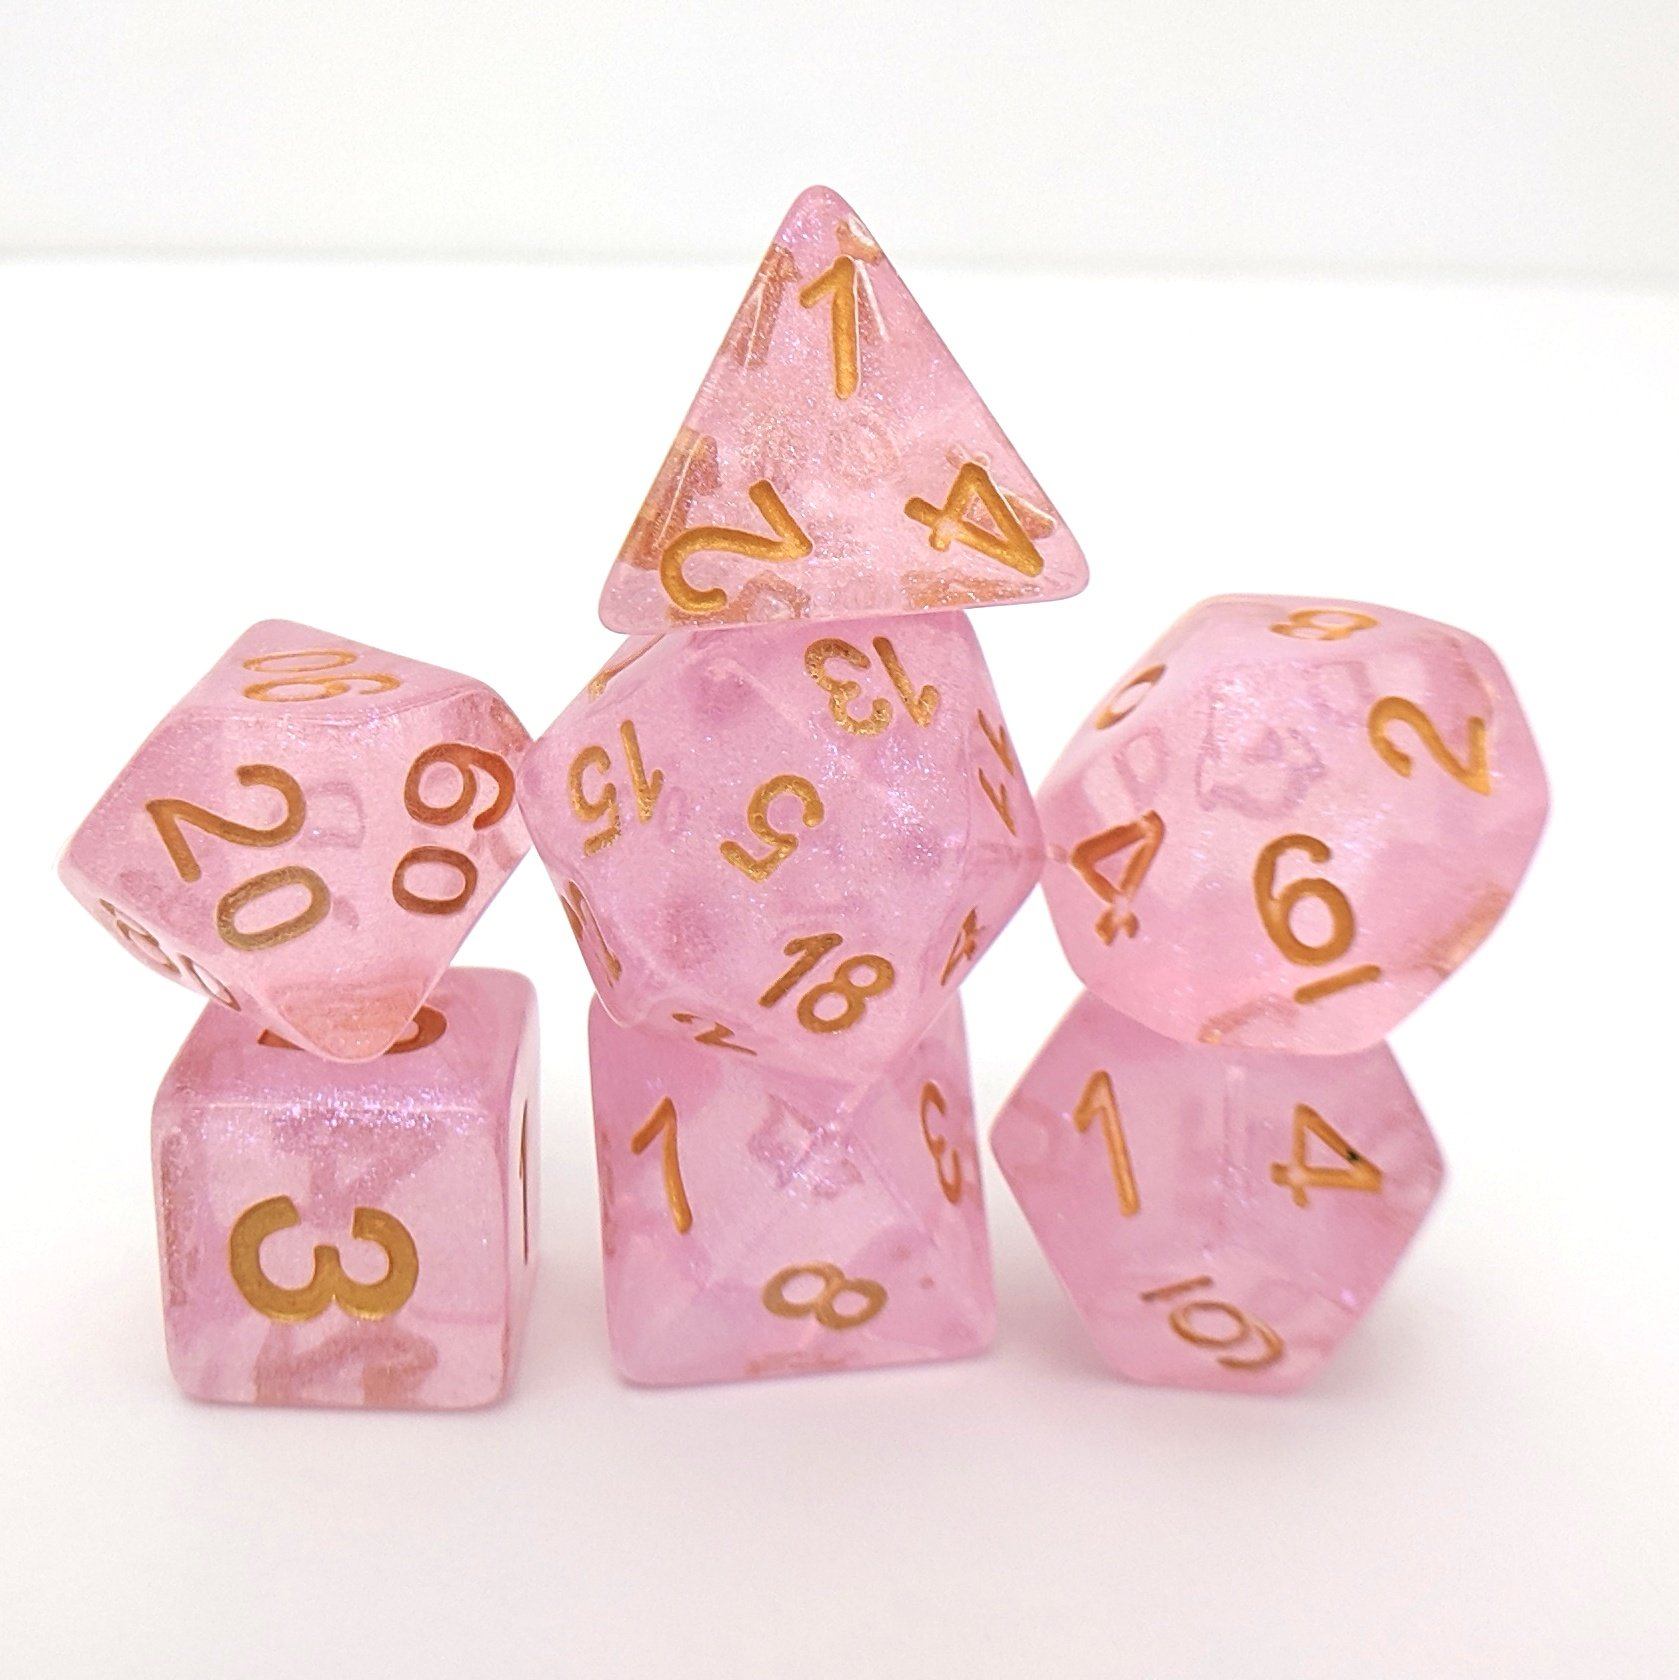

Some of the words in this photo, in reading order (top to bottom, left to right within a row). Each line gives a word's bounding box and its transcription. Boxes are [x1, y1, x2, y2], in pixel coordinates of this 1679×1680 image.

[800, 254, 861, 400] 1
[660, 479, 813, 613] 2
[904, 462, 1044, 577] 4
[804, 636, 941, 737] 13
[1270, 609, 1378, 640] 8
[567, 720, 664, 857] 15
[1367, 695, 1492, 796] 2
[146, 763, 331, 951] 20
[392, 743, 515, 915] 60
[720, 774, 825, 884] 5
[1070, 810, 1166, 946] 4
[758, 932, 895, 1033] 18
[921, 1081, 963, 1205] 3
[1073, 1070, 1140, 1217] 1
[1271, 1103, 1384, 1208] 4
[229, 1195, 419, 1323] 3
[762, 1261, 888, 1329] 8
